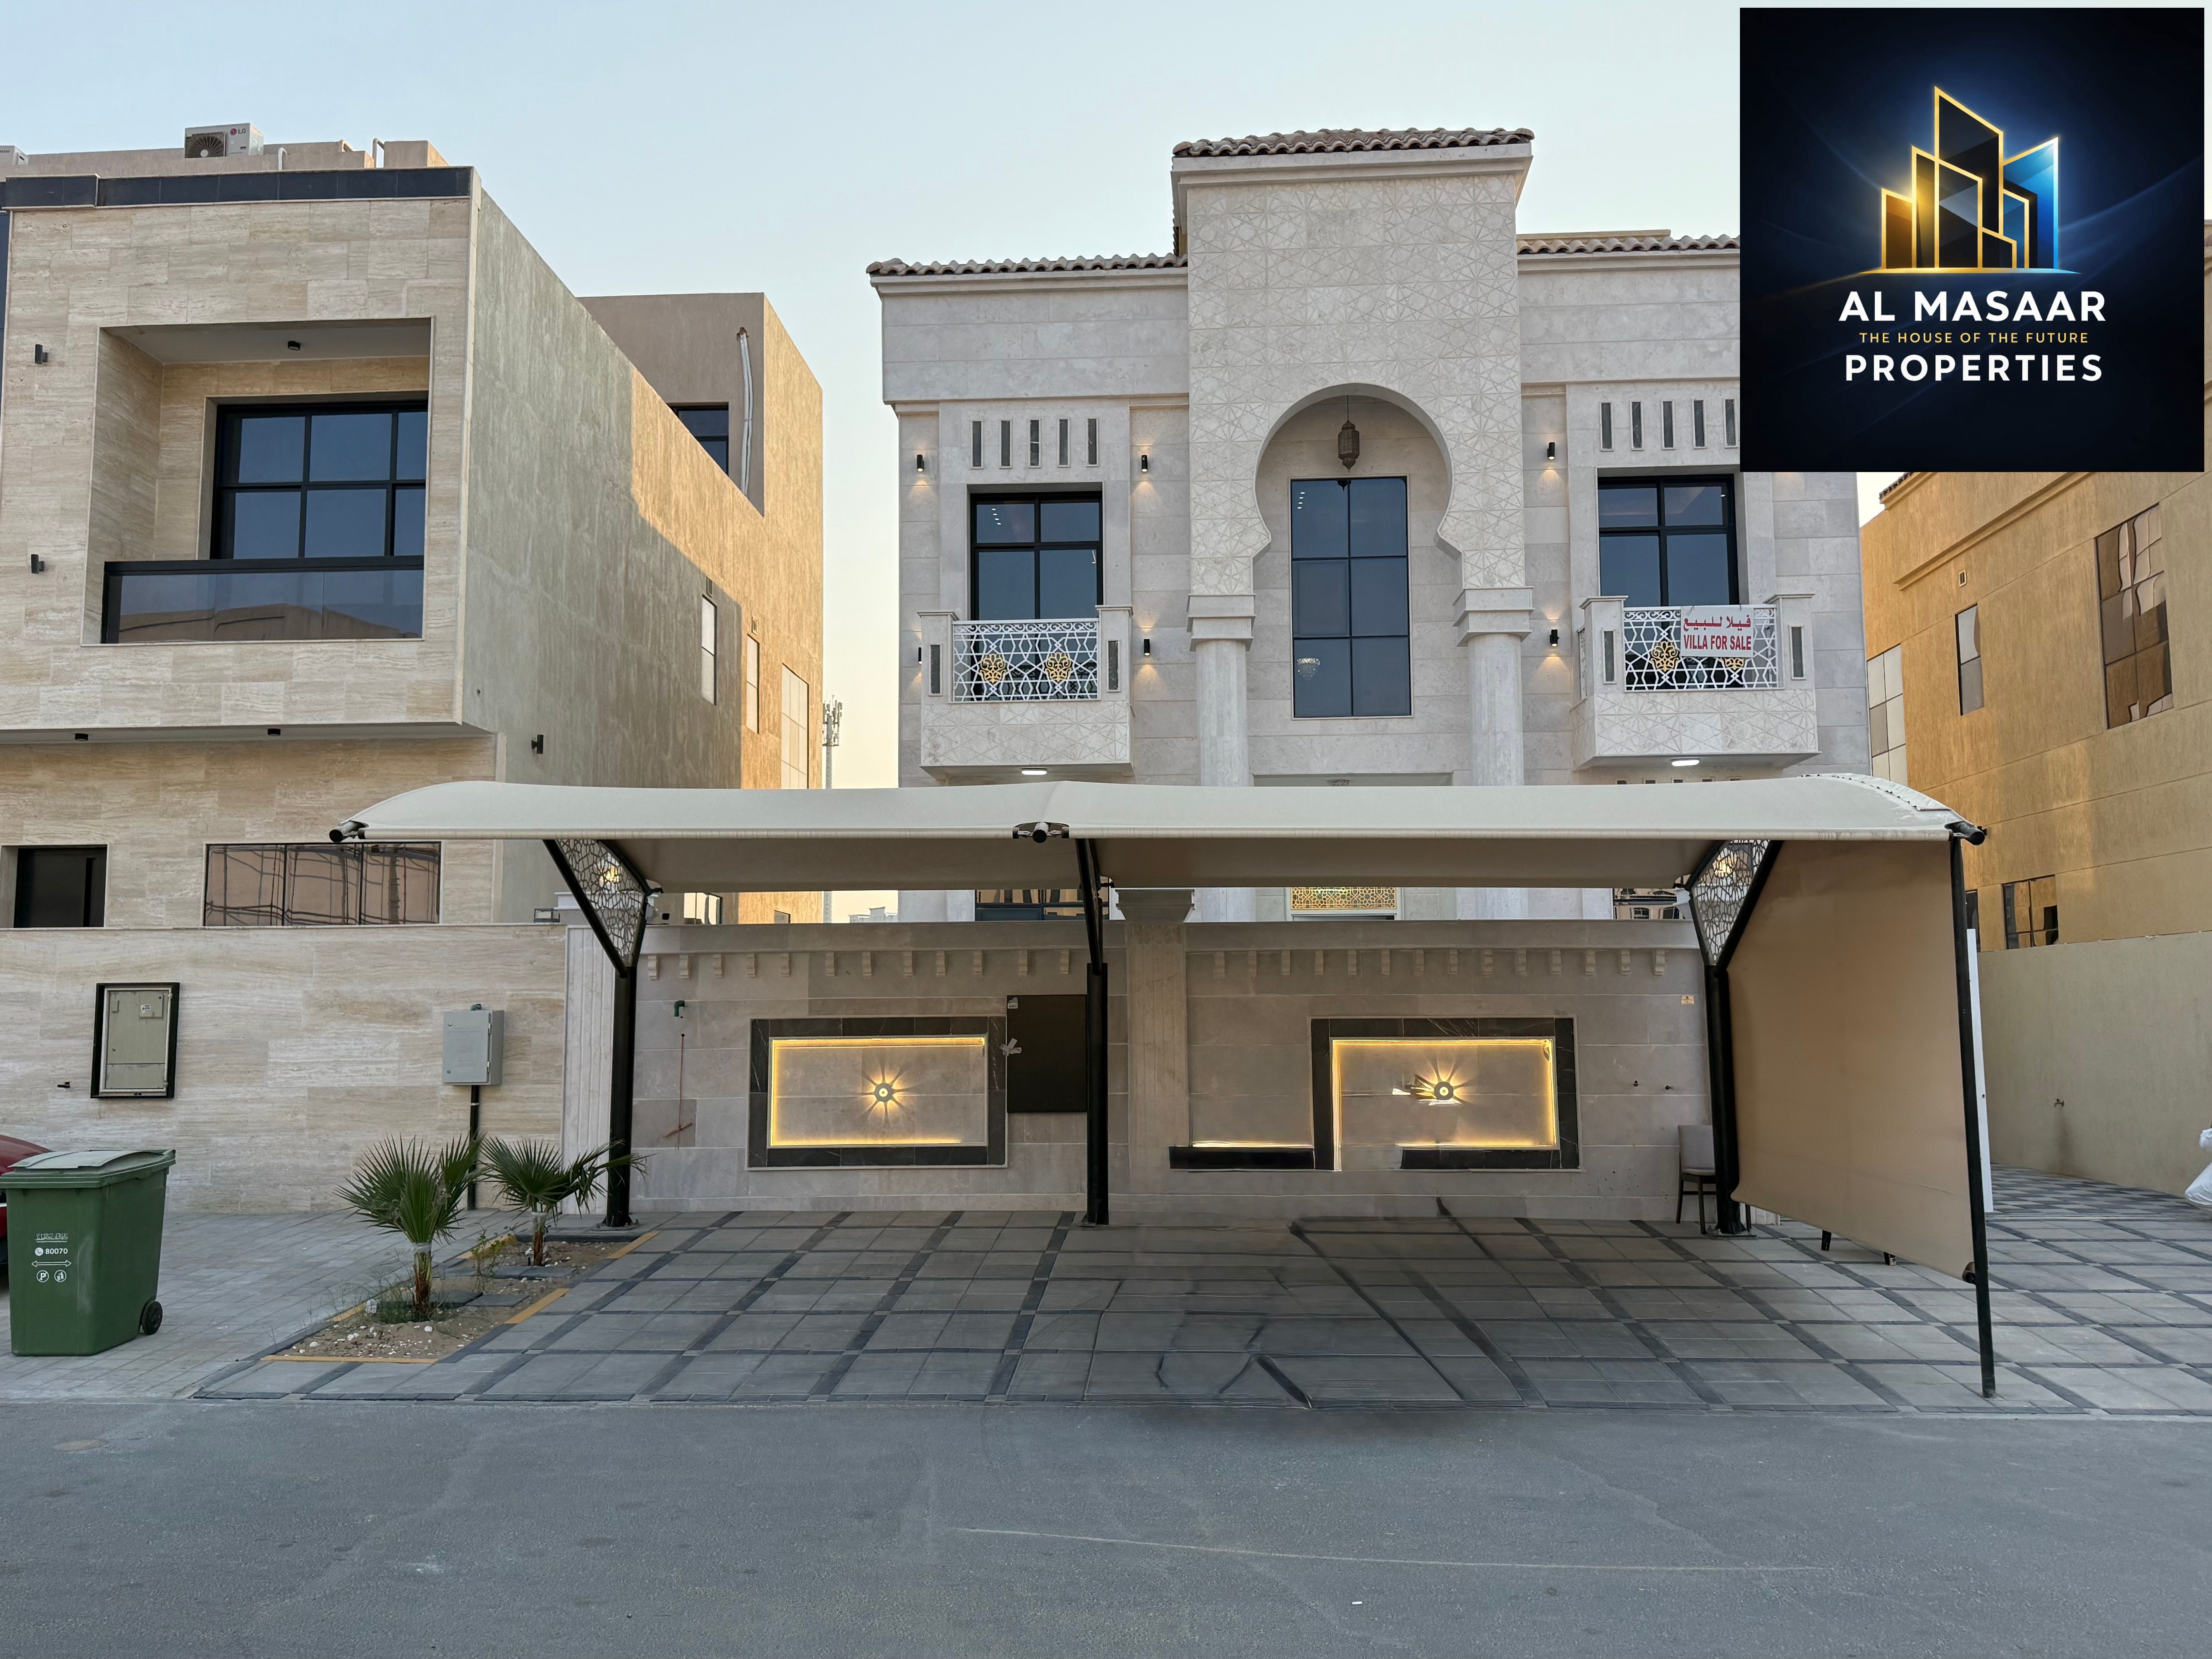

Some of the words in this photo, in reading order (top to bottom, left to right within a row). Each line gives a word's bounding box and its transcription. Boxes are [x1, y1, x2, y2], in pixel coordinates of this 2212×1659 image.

[1683, 616, 1722, 632] للبيع
[1726, 615, 1751, 631] فيلا
[1683, 635, 1708, 649] VILLA
[1711, 635, 1727, 650] FOR
[1730, 635, 1751, 650] SALE
